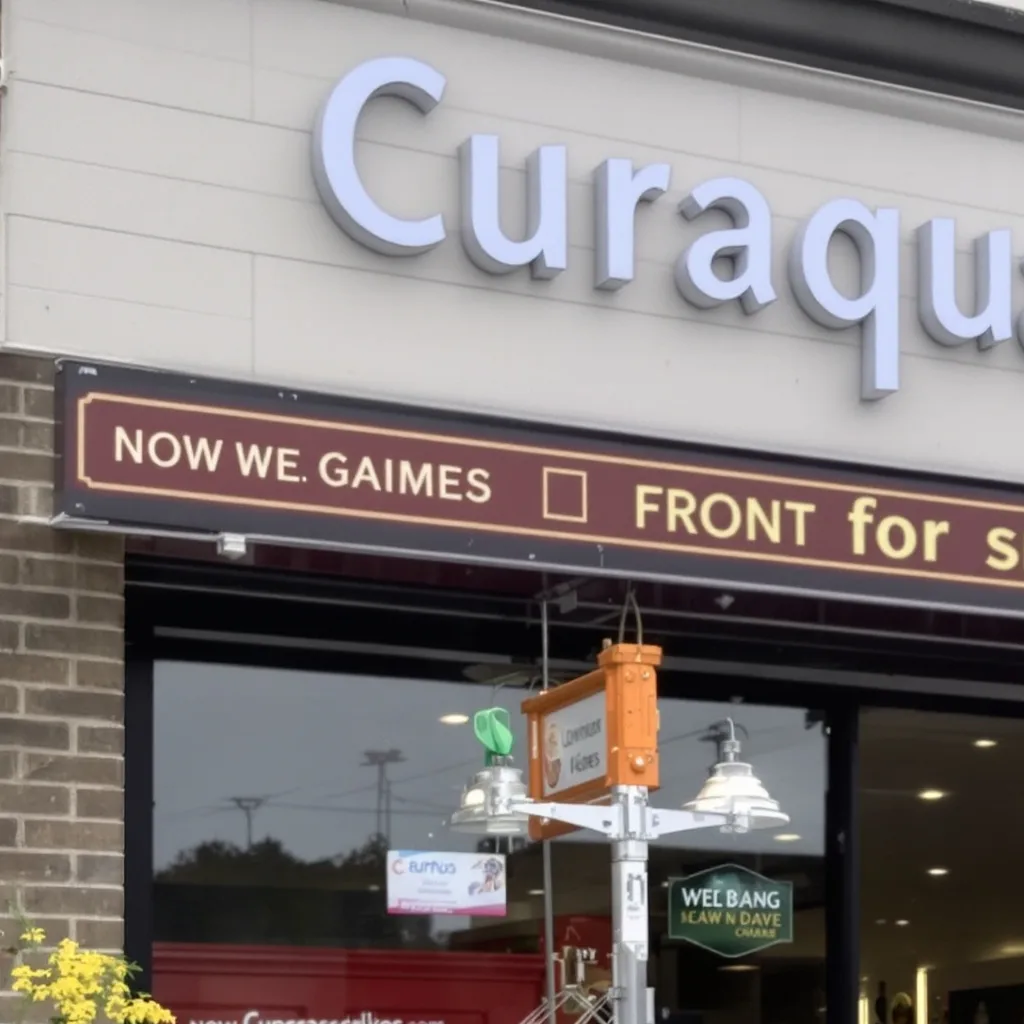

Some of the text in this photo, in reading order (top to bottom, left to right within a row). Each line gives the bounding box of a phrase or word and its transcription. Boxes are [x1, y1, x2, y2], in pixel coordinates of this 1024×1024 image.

[114, 426, 223, 472] NOW
[318, 452, 492, 503] GAIMES
[634, 484, 815, 547] FRONT
[848, 496, 949, 562] for
[681, 887, 780, 909] WEL BANG
[740, 911, 782, 928] DAVE
